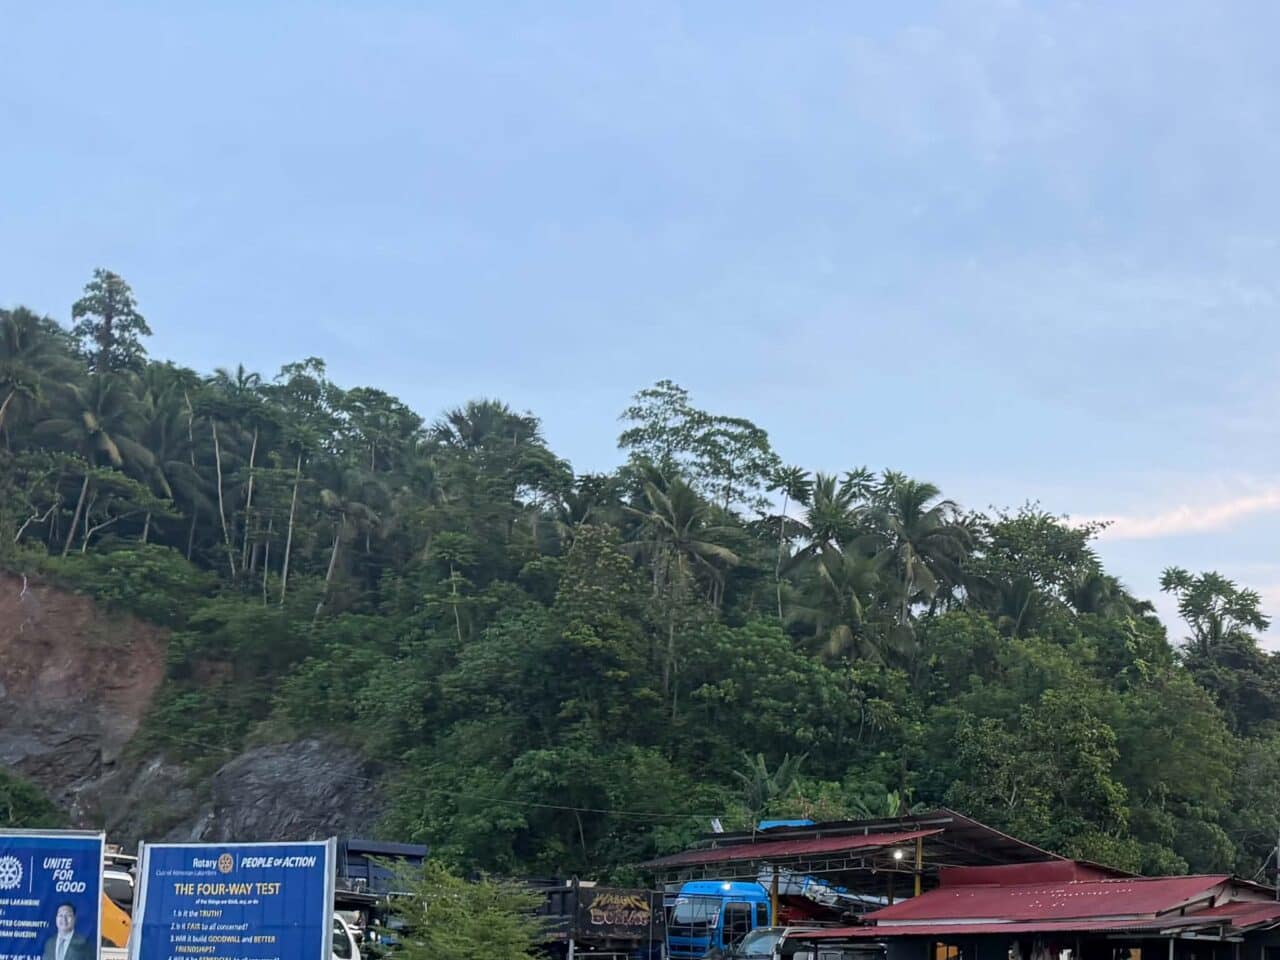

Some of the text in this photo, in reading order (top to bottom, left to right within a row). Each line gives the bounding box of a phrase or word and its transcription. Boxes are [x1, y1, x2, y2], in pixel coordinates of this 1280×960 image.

[43, 857, 72, 869] UNITE
[193, 858, 217, 869] Rotary
[241, 856, 274, 867] PEOPLE
[281, 856, 316, 867] ACTION
[52, 869, 74, 880] FOR
[56, 881, 86, 892] GOOD
[174, 882, 281, 895] THE FOUR-WAY TEST
